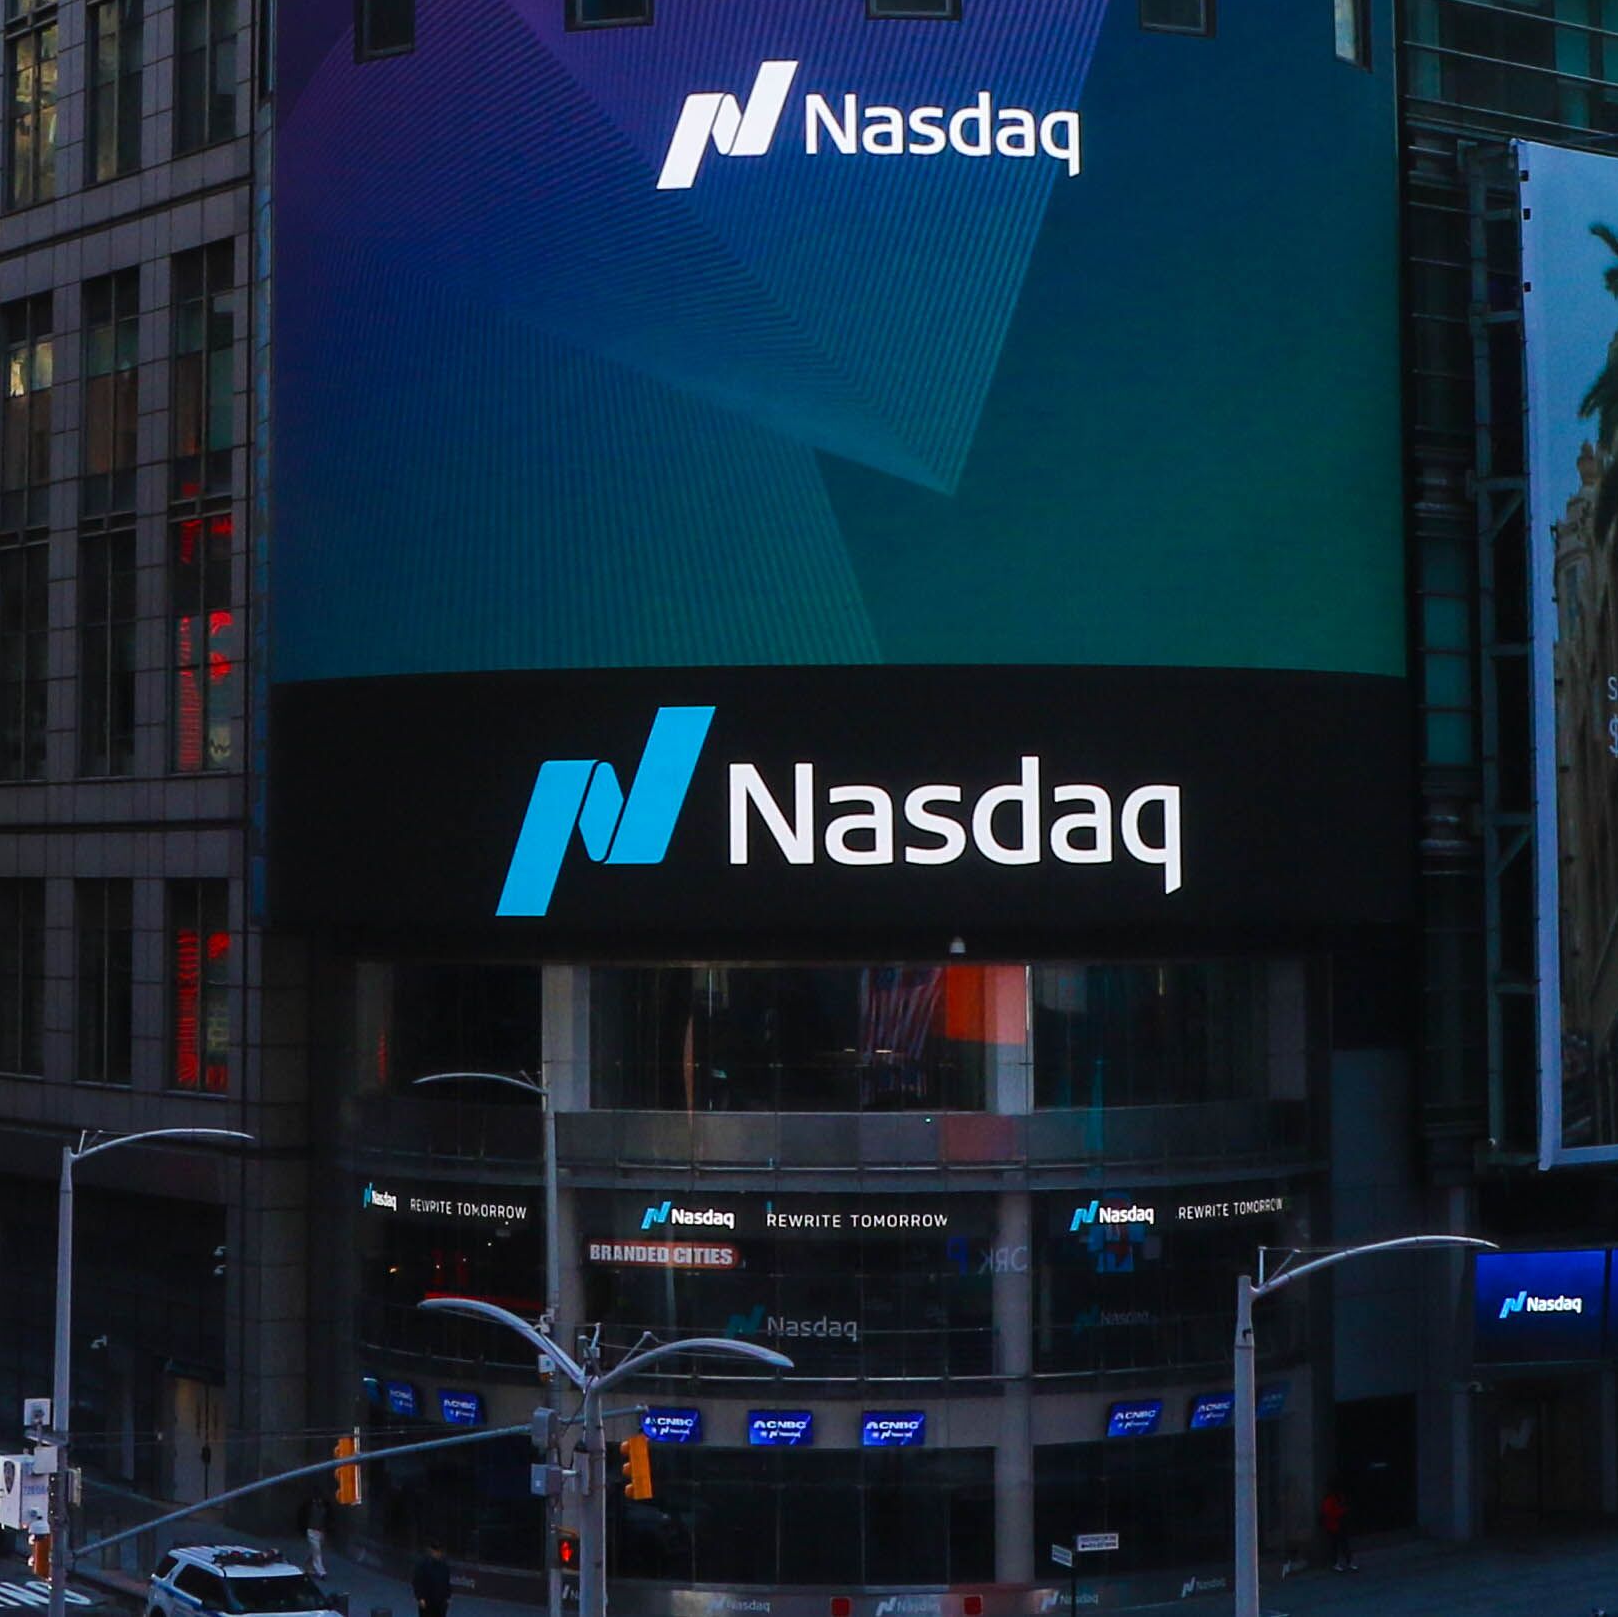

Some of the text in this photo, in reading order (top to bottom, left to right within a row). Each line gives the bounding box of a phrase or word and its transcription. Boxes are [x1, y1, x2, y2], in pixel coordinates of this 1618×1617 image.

[805, 91, 1080, 177] Nasdaq
[729, 755, 1182, 895] Nasdaq
[371, 1189, 398, 1213] Nasdaq
[457, 1201, 527, 1220] TOMORROW
[1098, 1197, 1284, 1225] Nasdaq REWRITE TOMORROW
[670, 1207, 948, 1230] Nasdaq REWRITE TOMORROW
[589, 1243, 734, 1266] BRANDED CITIES
[1525, 1294, 1583, 1314] Nasdaq
[766, 1314, 859, 1342] Nasdaq
[656, 1417, 694, 1428] CNBC
[766, 1420, 807, 1430] CNBC
[878, 1421, 920, 1430] CNBC
